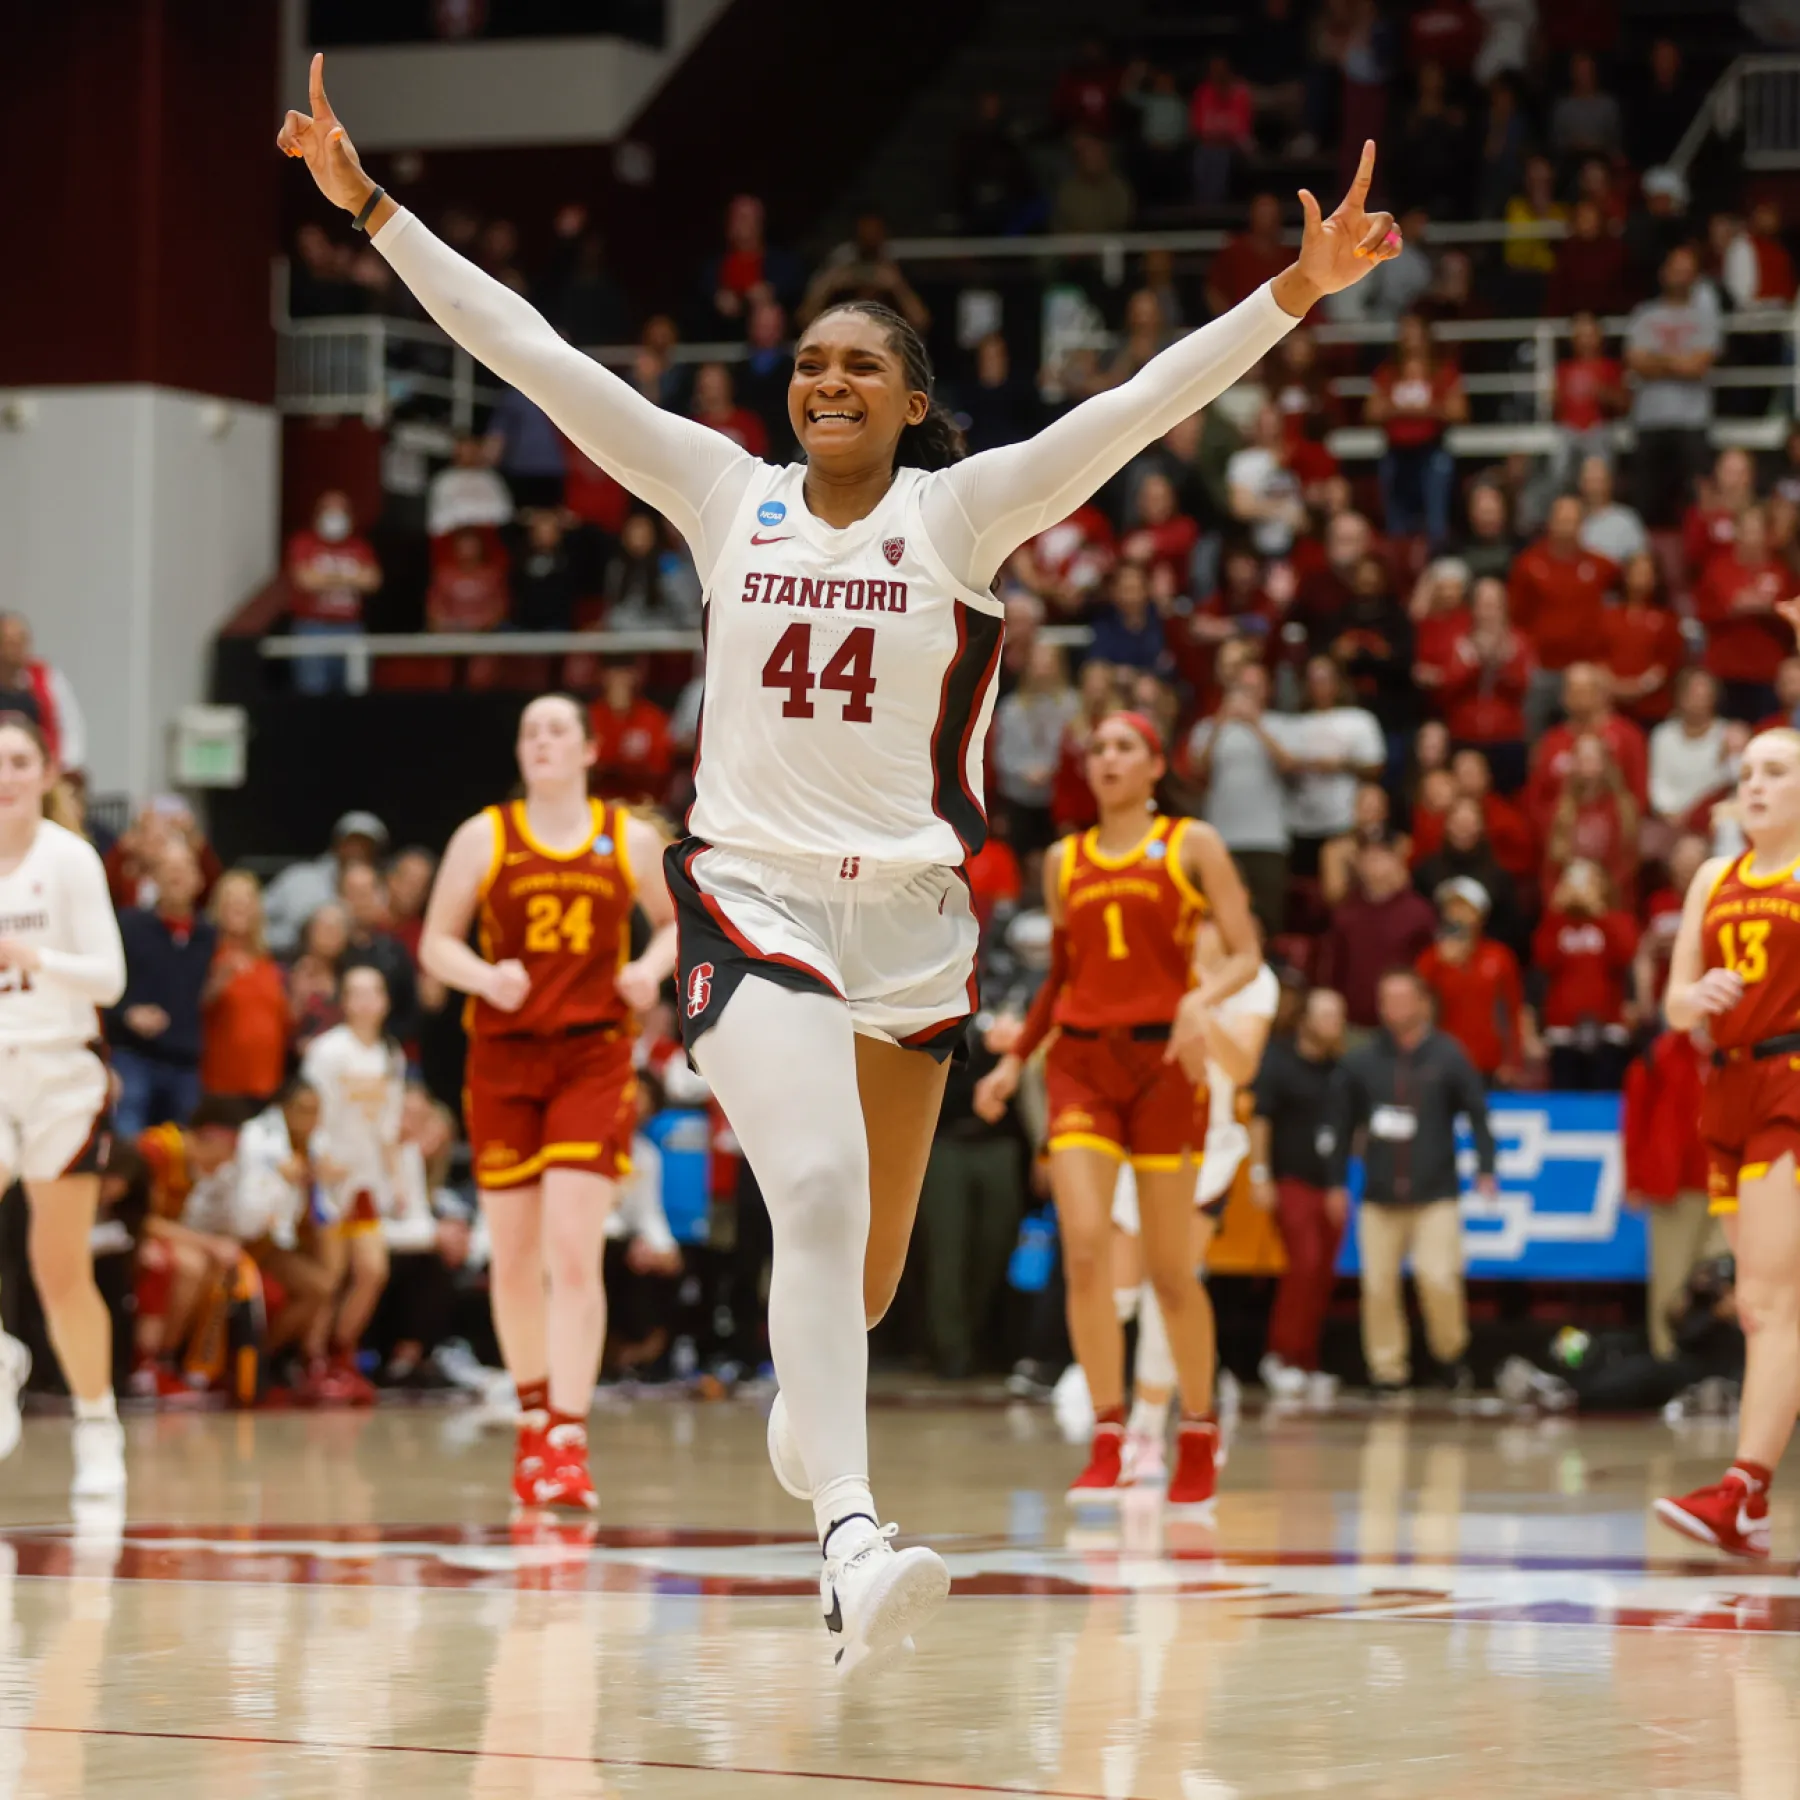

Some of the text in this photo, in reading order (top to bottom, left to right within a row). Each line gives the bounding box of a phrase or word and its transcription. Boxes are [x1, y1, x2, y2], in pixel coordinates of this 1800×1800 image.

[742, 572, 908, 613] STANFORD
[762, 622, 877, 723] 44
[526, 894, 594, 954] 24
[1103, 901, 1129, 960] 1
[1718, 919, 1771, 983] 13
